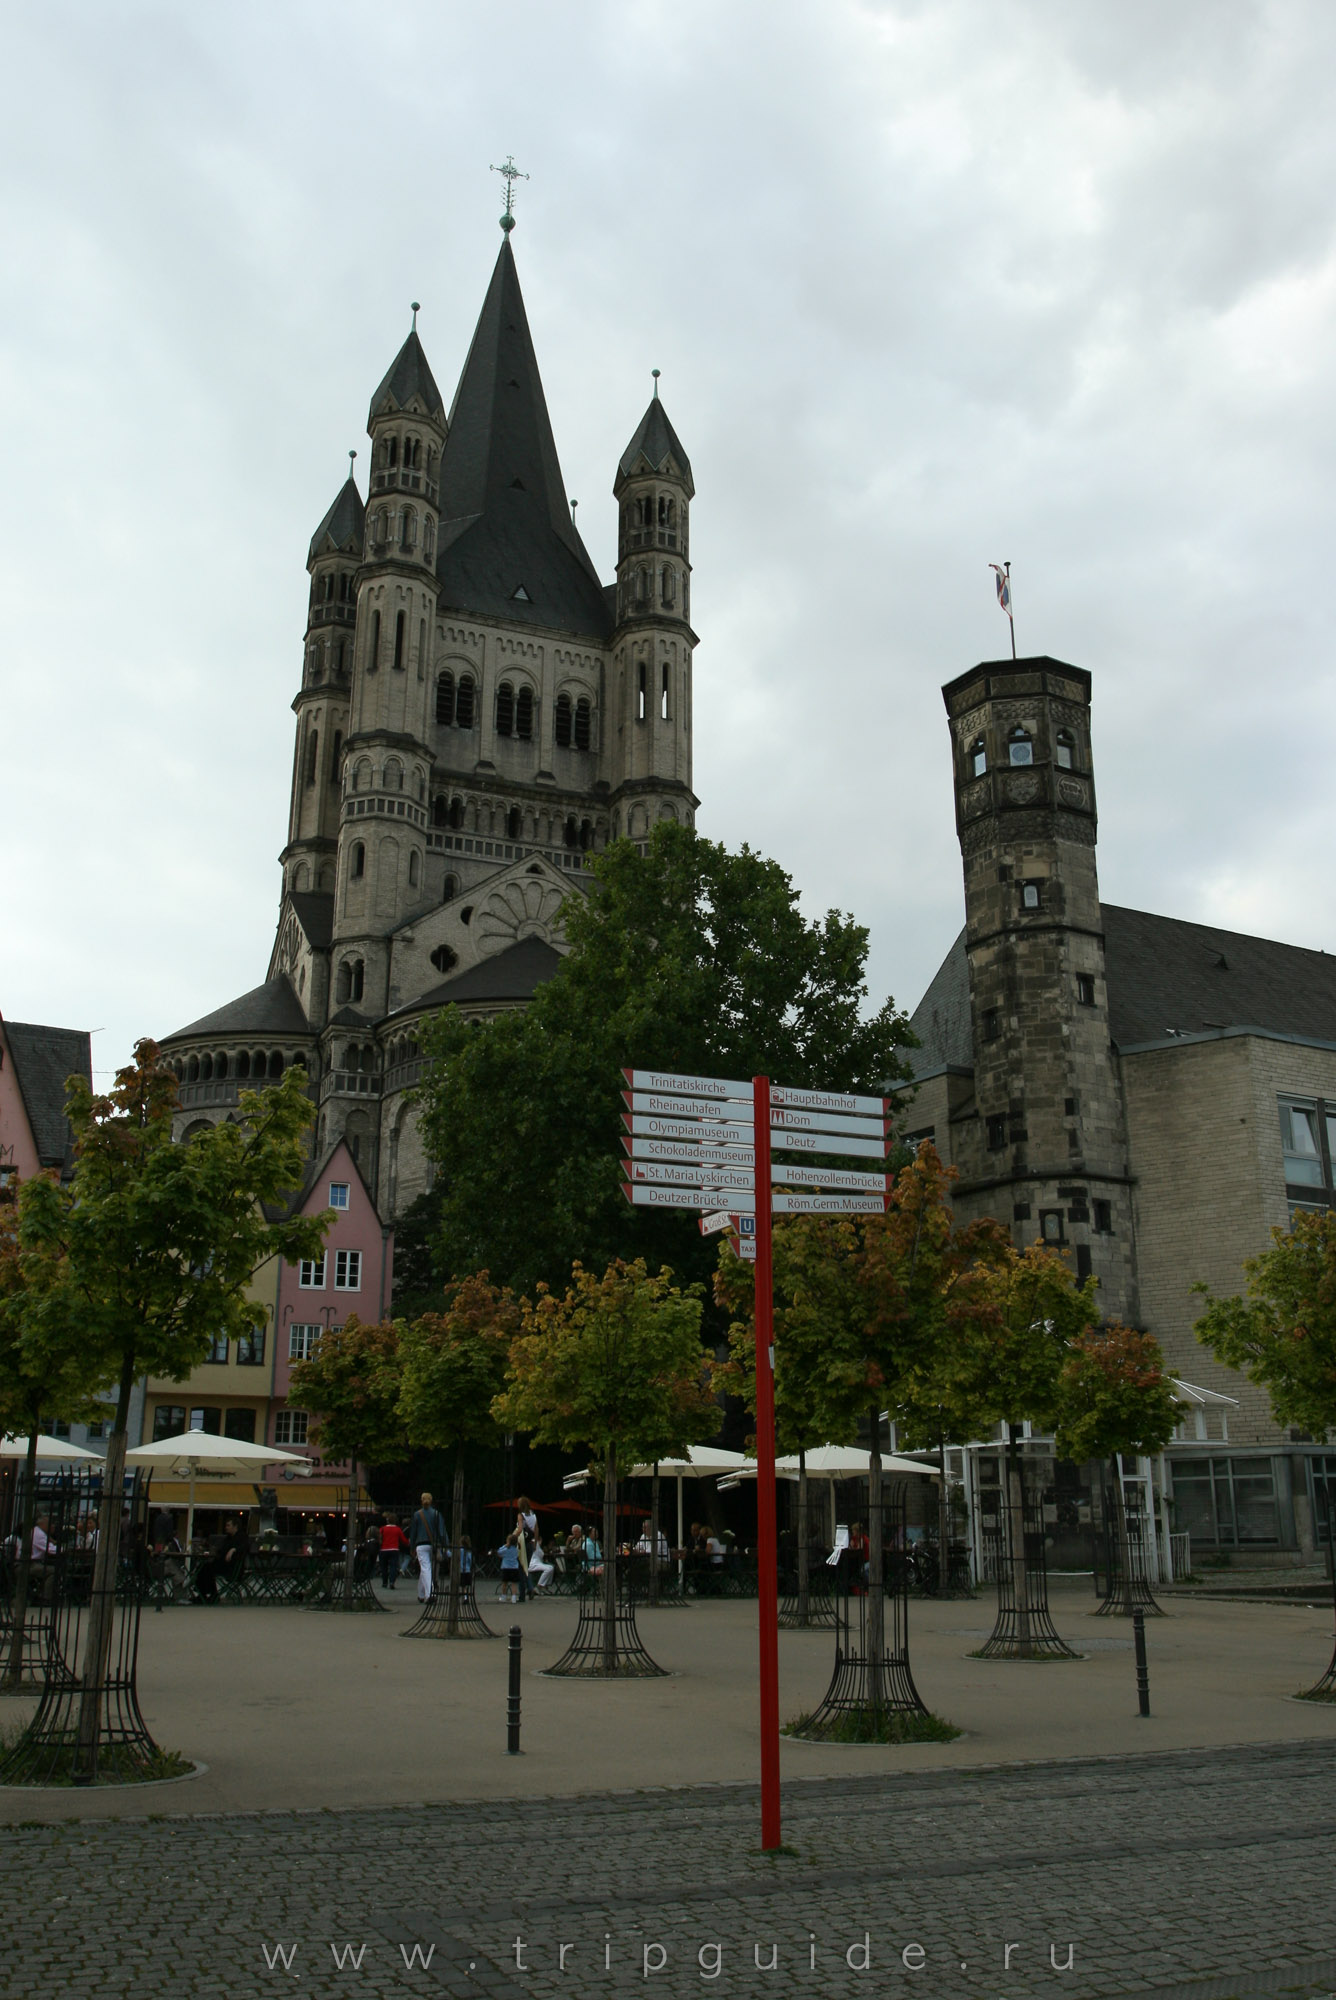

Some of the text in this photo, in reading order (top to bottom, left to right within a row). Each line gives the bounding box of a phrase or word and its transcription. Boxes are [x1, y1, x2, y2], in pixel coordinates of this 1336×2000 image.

[649, 1075, 726, 1094] Trinitatiskirche
[649, 1098, 721, 1115] Rheinauhafen
[785, 1091, 857, 1109] Hauptbahnhof
[785, 1113, 811, 1125] Dom
[649, 1120, 740, 1139] Olympiamuseum
[786, 1135, 816, 1148] Deutz
[648, 1142, 754, 1162] Schokoladenmuseum
[649, 1167, 749, 1185] St. Maria Lyskirchen
[786, 1169, 883, 1188] Hohenzollernbrücke
[649, 1190, 729, 1207] Deutzer Brücke
[743, 1220, 752, 1231] U
